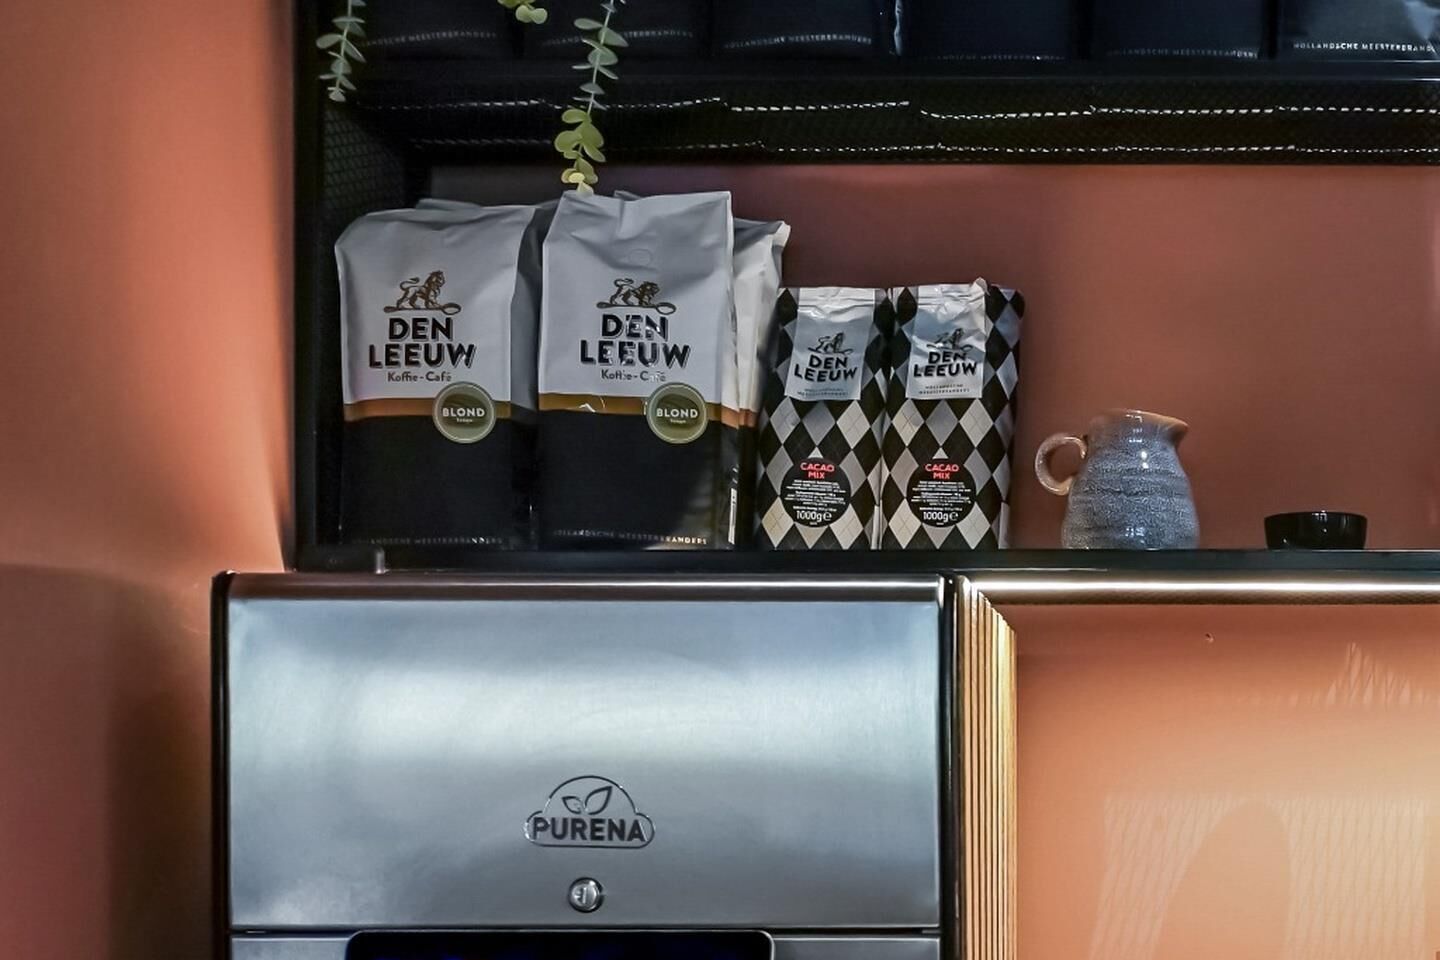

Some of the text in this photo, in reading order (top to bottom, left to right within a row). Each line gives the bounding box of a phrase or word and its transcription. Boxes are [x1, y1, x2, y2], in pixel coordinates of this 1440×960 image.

[388, 317, 454, 342] DEN
[601, 313, 668, 342] DEN
[368, 343, 477, 369] LEEUW
[580, 340, 691, 370] LEEUW
[808, 353, 848, 370] DEN
[928, 350, 967, 365] DEN
[794, 363, 858, 383] LEEUW
[913, 361, 977, 378] LEEUW
[442, 407, 486, 418] BLOND
[656, 407, 699, 419] BLOND
[800, 462, 835, 473] CACAO
[808, 471, 826, 480] MIX
[924, 463, 960, 473] CACAO
[933, 472, 951, 480] MIX
[532, 816, 647, 842] PURENA
